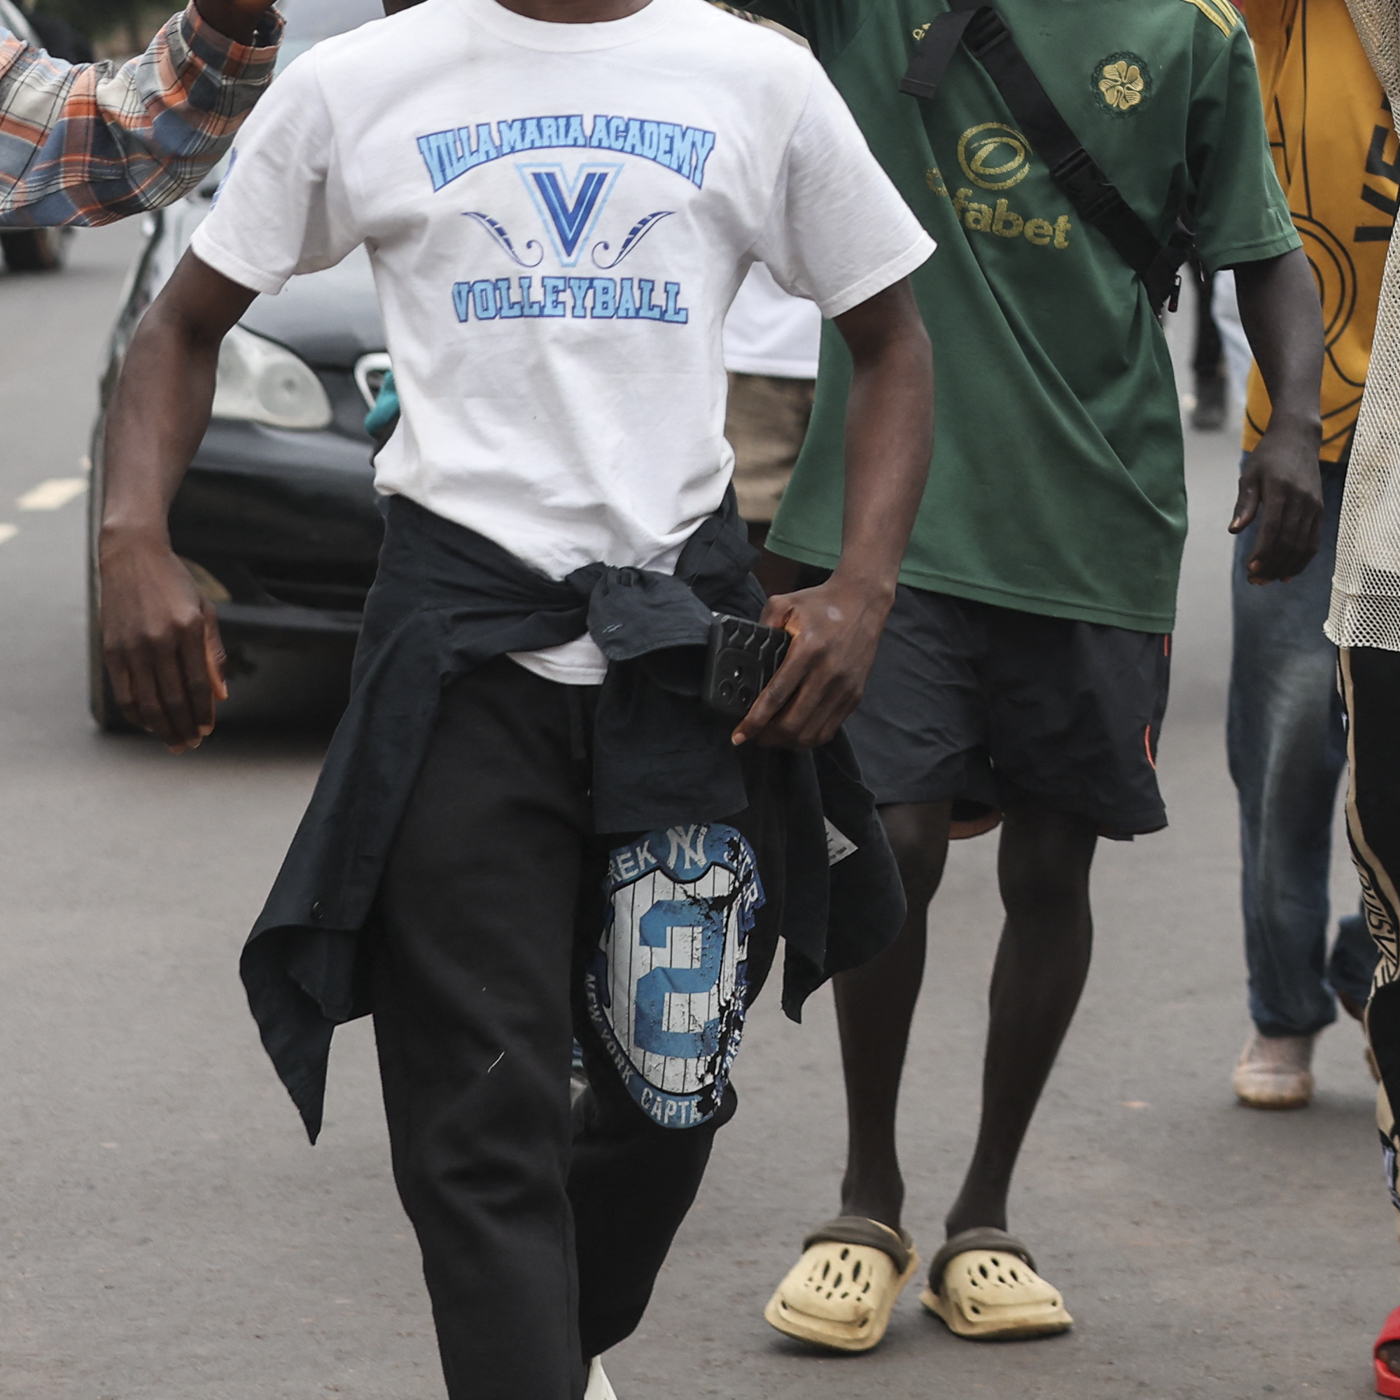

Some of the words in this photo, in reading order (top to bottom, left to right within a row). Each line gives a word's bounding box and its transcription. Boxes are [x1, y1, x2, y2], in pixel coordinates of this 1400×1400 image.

[416, 121, 500, 193] VILLA
[497, 114, 588, 156] MARIA
[590, 114, 717, 190] ACADEMY
[514, 162, 625, 267] V
[452, 276, 688, 325] VOLLEYBALL
[665, 824, 709, 870] NY
[634, 899, 727, 1059] 2
[585, 972, 603, 1023] NEW
[600, 1029, 635, 1086] YORK
[640, 1086, 703, 1125] CAPTA
